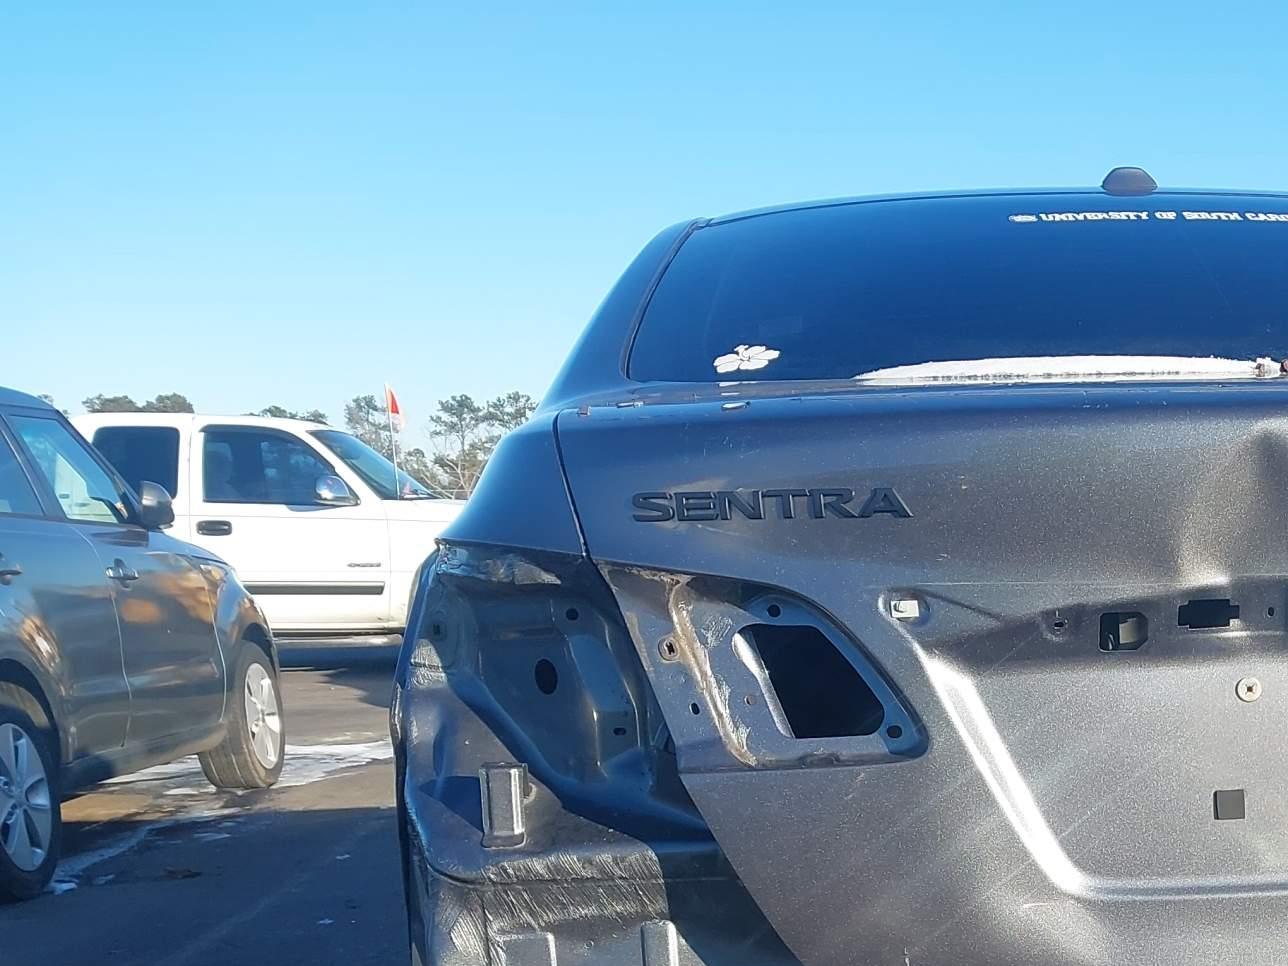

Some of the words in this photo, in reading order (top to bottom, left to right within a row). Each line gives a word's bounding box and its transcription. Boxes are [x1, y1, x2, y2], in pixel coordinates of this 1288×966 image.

[1039, 211, 1149, 221] UNIVERSITY
[1182, 211, 1243, 221] SOUTH
[632, 487, 914, 522] SENTRA
